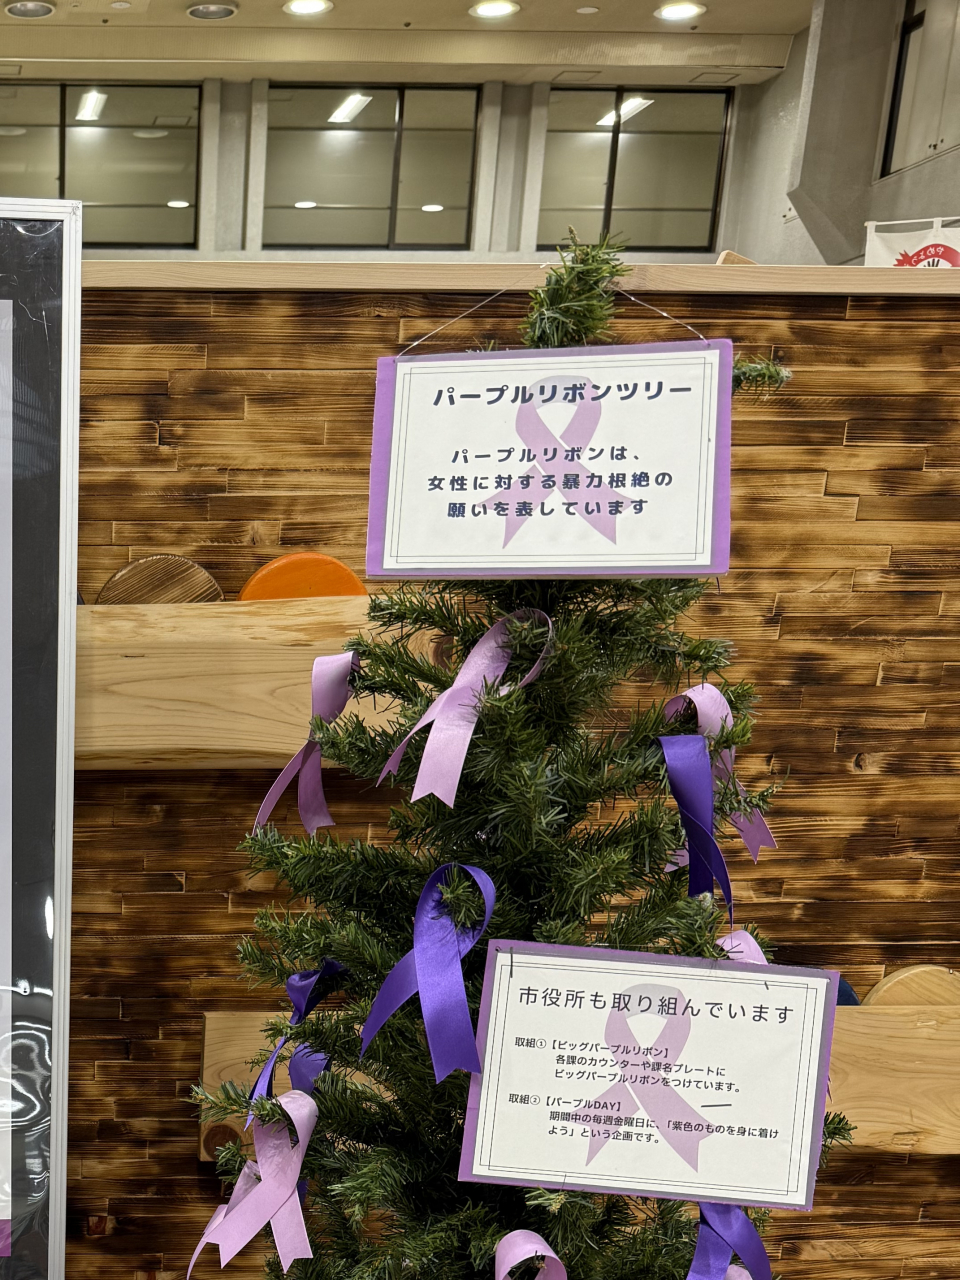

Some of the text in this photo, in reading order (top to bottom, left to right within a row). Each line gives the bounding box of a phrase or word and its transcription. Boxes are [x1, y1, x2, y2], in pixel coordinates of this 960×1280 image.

[432, 380, 693, 407] パープルリボンツリー
[451, 445, 641, 465] パープルリボンは、
[427, 471, 673, 492] 女性に対する暴力根絶の
[447, 498, 649, 518] 願いを表しています
[518, 985, 794, 1024] 市役所も取り組んでいます
[555, 1053, 726, 1078] 各課のカウンターや課名プレートに
[554, 1068, 740, 1094] ビッグパープルリボンをつけています。
[548, 1125, 661, 1146] よう」という企画です。
[549, 1110, 780, 1140] 期間中の毎週金曜日に、「紫色のものを身に着け
